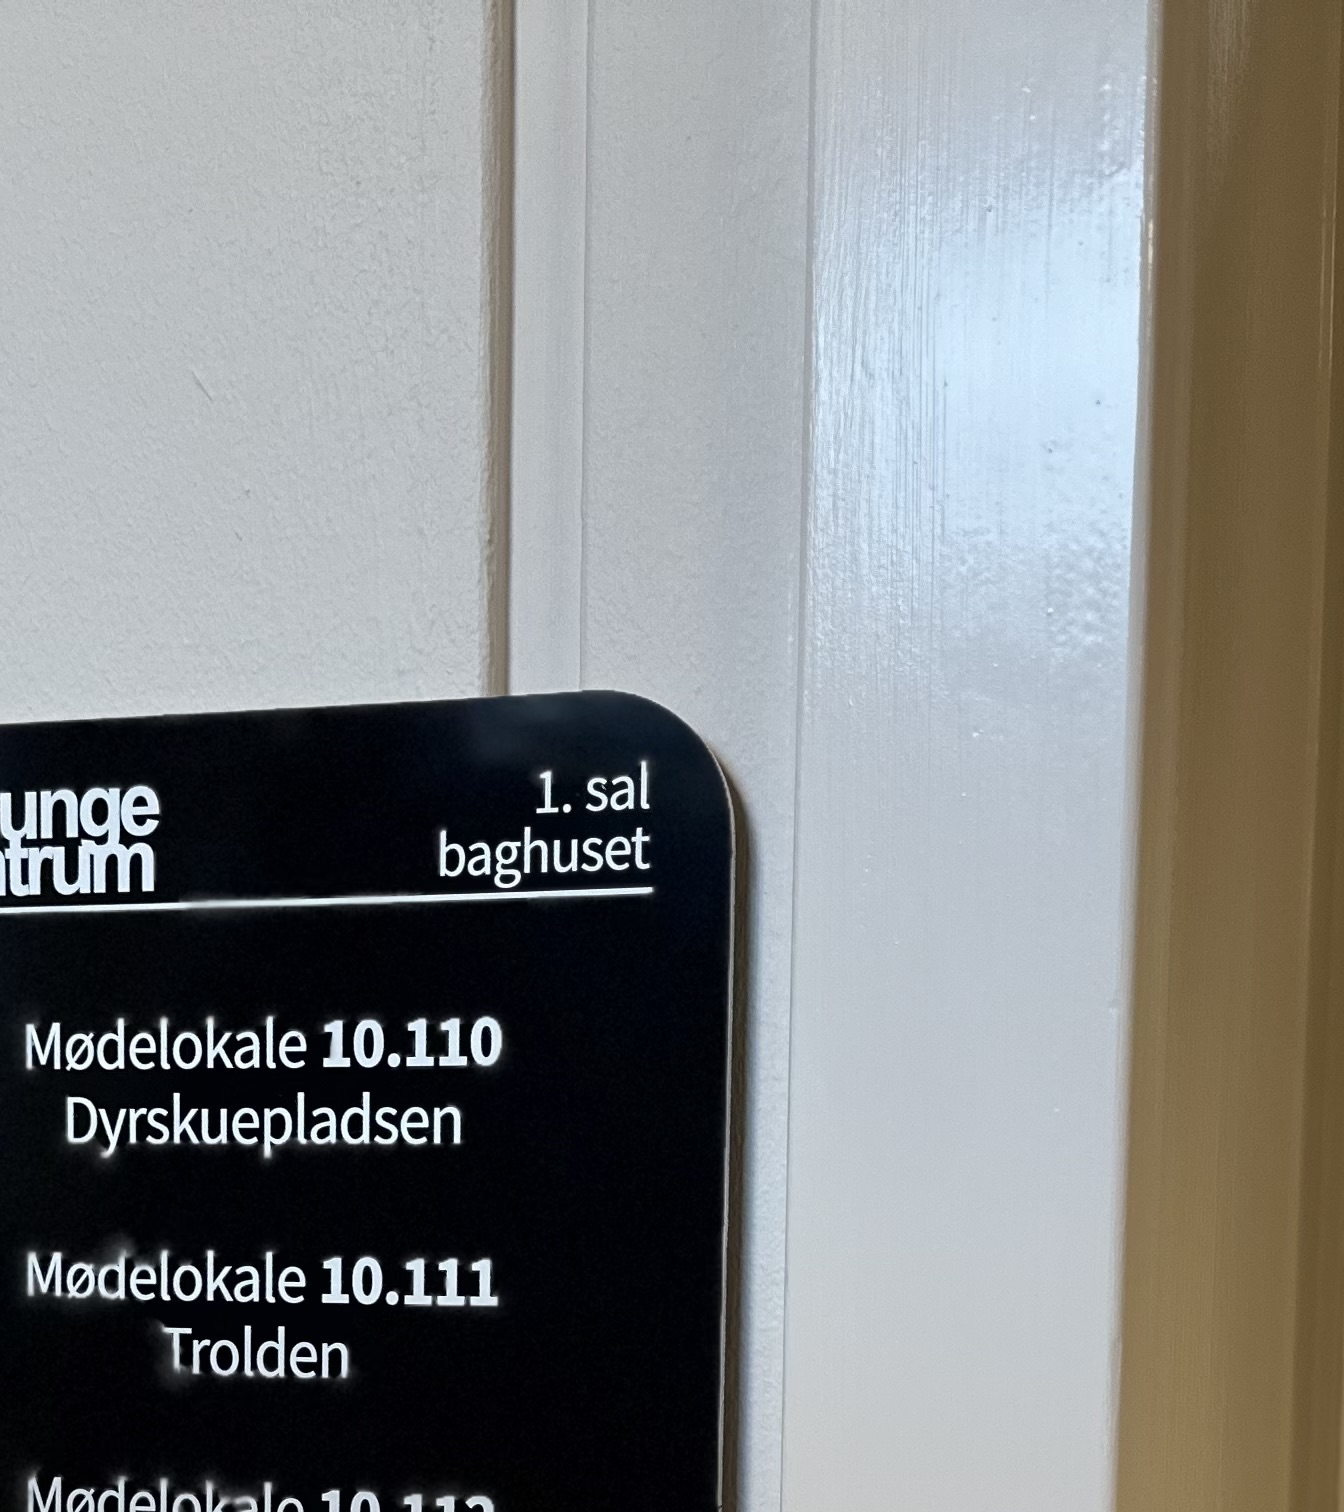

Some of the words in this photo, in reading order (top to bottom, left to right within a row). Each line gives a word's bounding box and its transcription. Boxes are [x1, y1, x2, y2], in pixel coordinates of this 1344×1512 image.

[536, 771, 571, 813] 1.
[586, 760, 650, 811] sal
[0, 784, 160, 847] unge
[440, 827, 650, 887] baghuset
[26, 1016, 306, 1071] Mødelokale
[323, 1016, 502, 1068] 10.110
[67, 1092, 461, 1158] Dyrskuepladsen
[27, 1250, 306, 1303] Mødelokale
[322, 1257, 498, 1306] 10.111
[162, 1326, 348, 1378] Trolden
